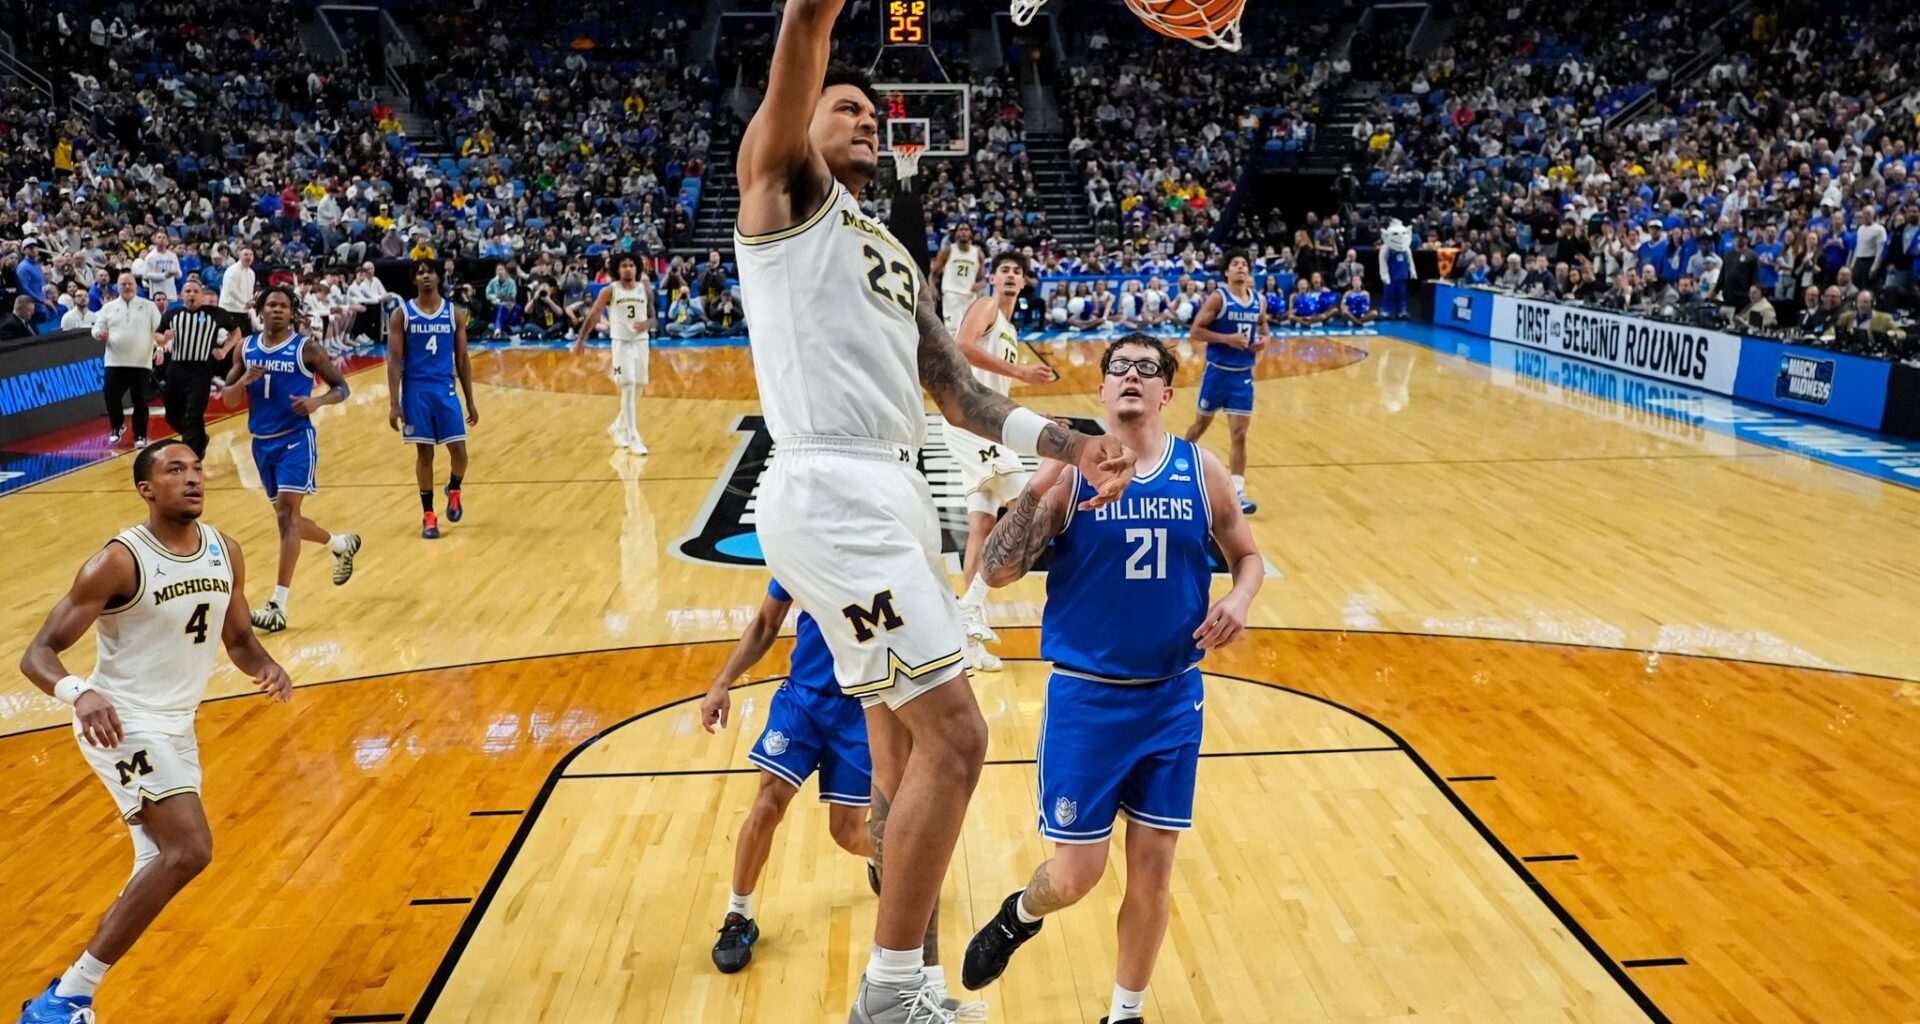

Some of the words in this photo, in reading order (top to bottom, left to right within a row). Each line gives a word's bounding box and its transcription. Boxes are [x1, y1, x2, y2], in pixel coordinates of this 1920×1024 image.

[890, 1, 925, 15] 15:12
[890, 16, 921, 41] 25
[863, 244, 915, 315] 23
[957, 265, 969, 277] 21
[627, 305, 635, 318] 3
[410, 324, 451, 333] BILLIKENS
[425, 335, 438, 355] 4
[1516, 304, 1550, 345] FIRST
[1563, 312, 1620, 362] SECOND
[1625, 324, 1709, 381] ROUNDS
[1788, 358, 1817, 379] MARCH
[264, 374, 271, 399] 1
[1789, 376, 1831, 400] MADNESS
[899, 448, 909, 462] M
[978, 445, 1000, 463] M
[1095, 497, 1193, 521] BILLIKENS
[1125, 528, 1168, 580] 21
[153, 577, 230, 606] MICHIGAN
[184, 602, 211, 645] 4
[841, 589, 905, 644] M
[114, 749, 154, 787] M
